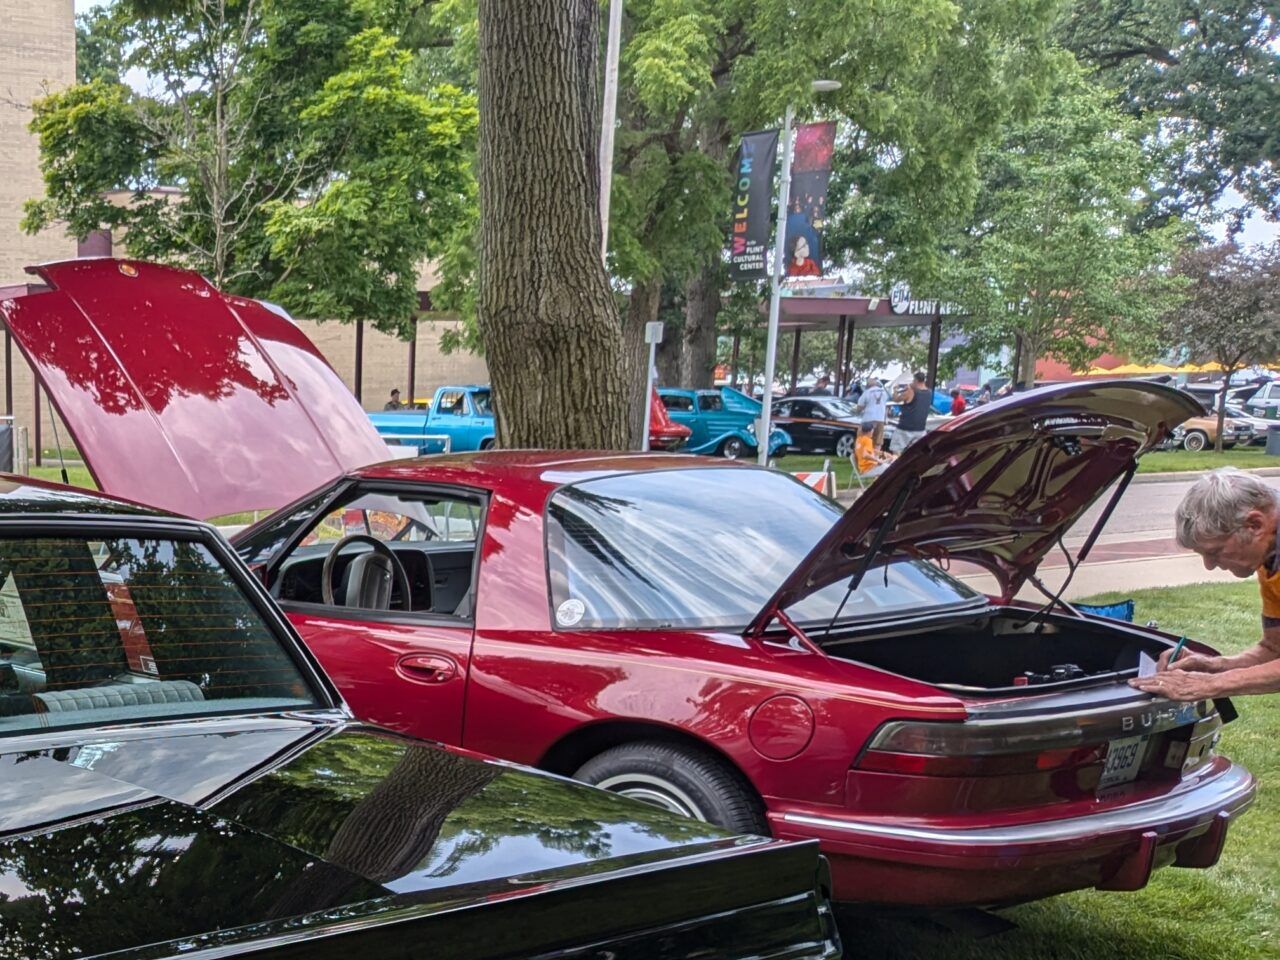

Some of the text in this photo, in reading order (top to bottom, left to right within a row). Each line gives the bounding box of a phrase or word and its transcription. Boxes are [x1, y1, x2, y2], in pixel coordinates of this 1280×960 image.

[734, 143, 754, 254] WELCOME
[746, 245, 764, 254] FLINT
[733, 254, 764, 263] CULTURAL
[739, 262, 764, 271] CENTER
[908, 300, 938, 315] FLINT
